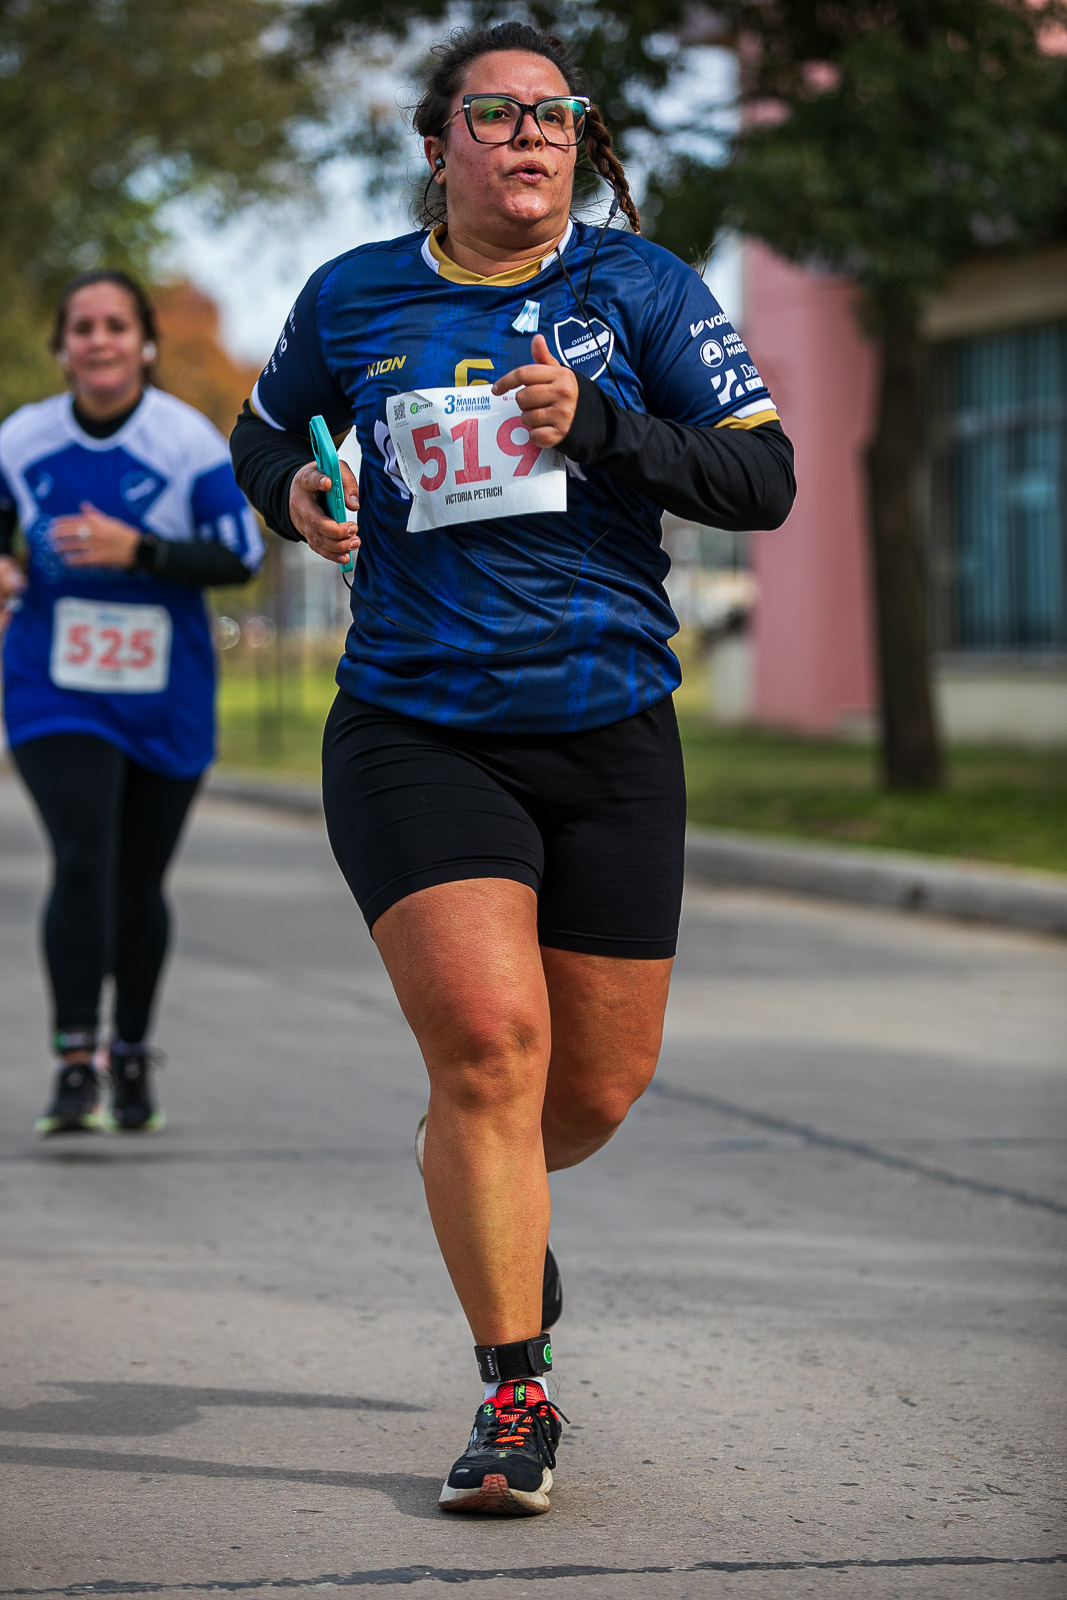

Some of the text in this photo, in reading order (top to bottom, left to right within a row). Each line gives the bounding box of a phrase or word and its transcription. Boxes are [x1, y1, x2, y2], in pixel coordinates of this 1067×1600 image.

[444, 394, 456, 415] 3
[456, 396, 490, 406] MARATÓN
[411, 415, 543, 492] 519
[445, 486, 503, 505] VICTORIA PETRICH
[67, 623, 157, 670] 525
